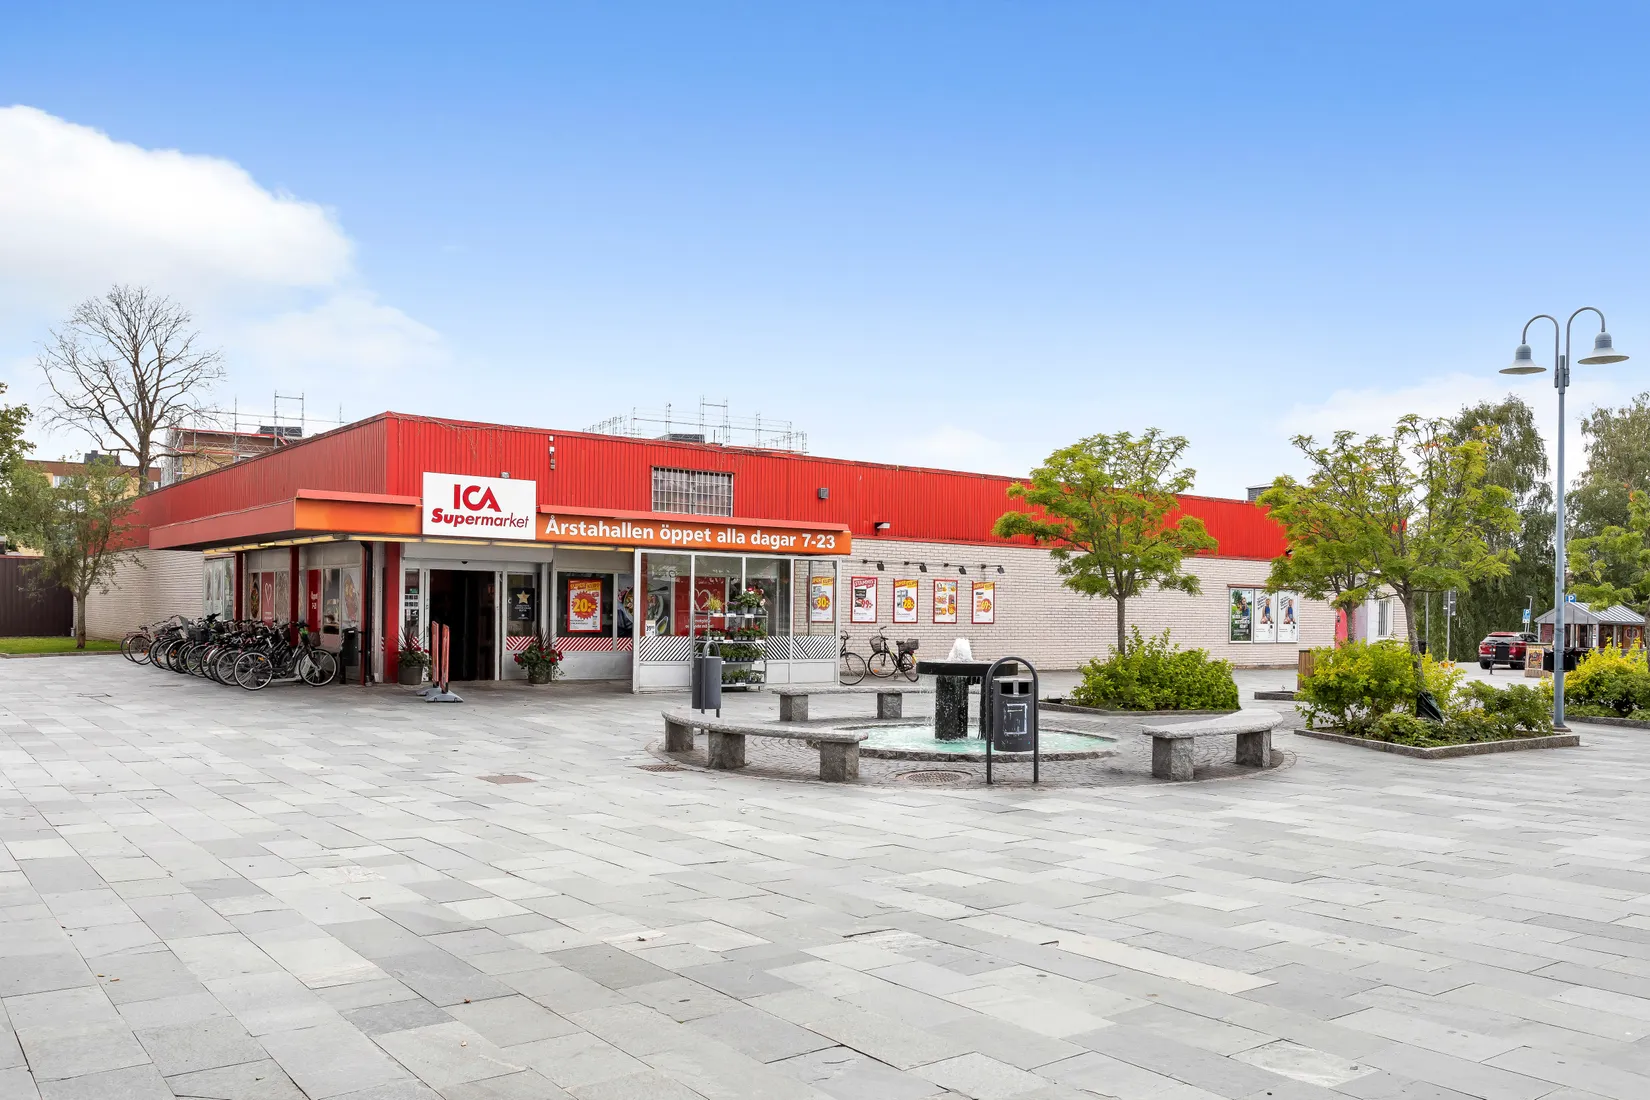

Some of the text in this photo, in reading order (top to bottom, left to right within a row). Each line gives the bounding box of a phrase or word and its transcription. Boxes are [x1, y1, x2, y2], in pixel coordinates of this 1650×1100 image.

[454, 484, 502, 512] ICA
[431, 508, 530, 529] Supermarket
[545, 515, 836, 550] Årstahallen öppet alla dagar 7-23
[573, 598, 596, 613] 20:-
